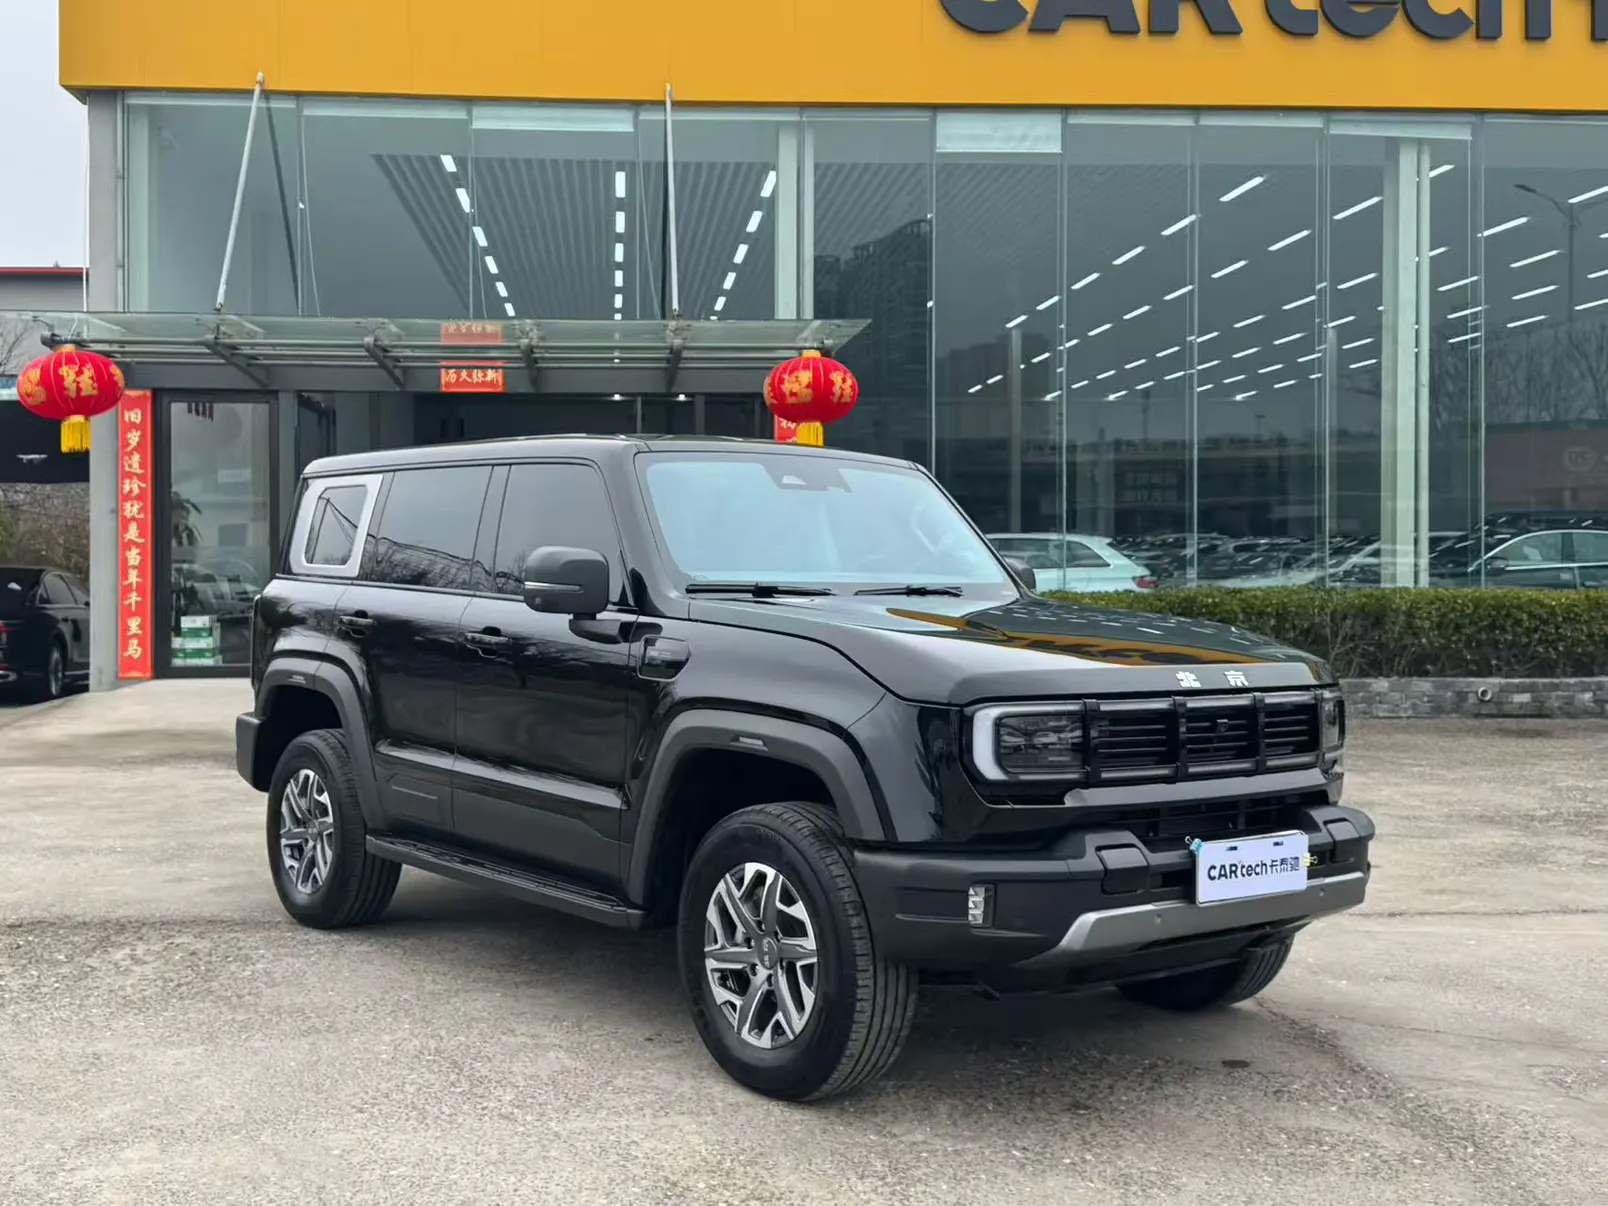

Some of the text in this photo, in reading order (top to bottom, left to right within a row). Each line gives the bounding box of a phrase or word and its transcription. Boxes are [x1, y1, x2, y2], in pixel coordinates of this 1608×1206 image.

[122, 408, 146, 660] 旧岁遗珍犹是当年千里马
[1176, 670, 1250, 687] 北京
